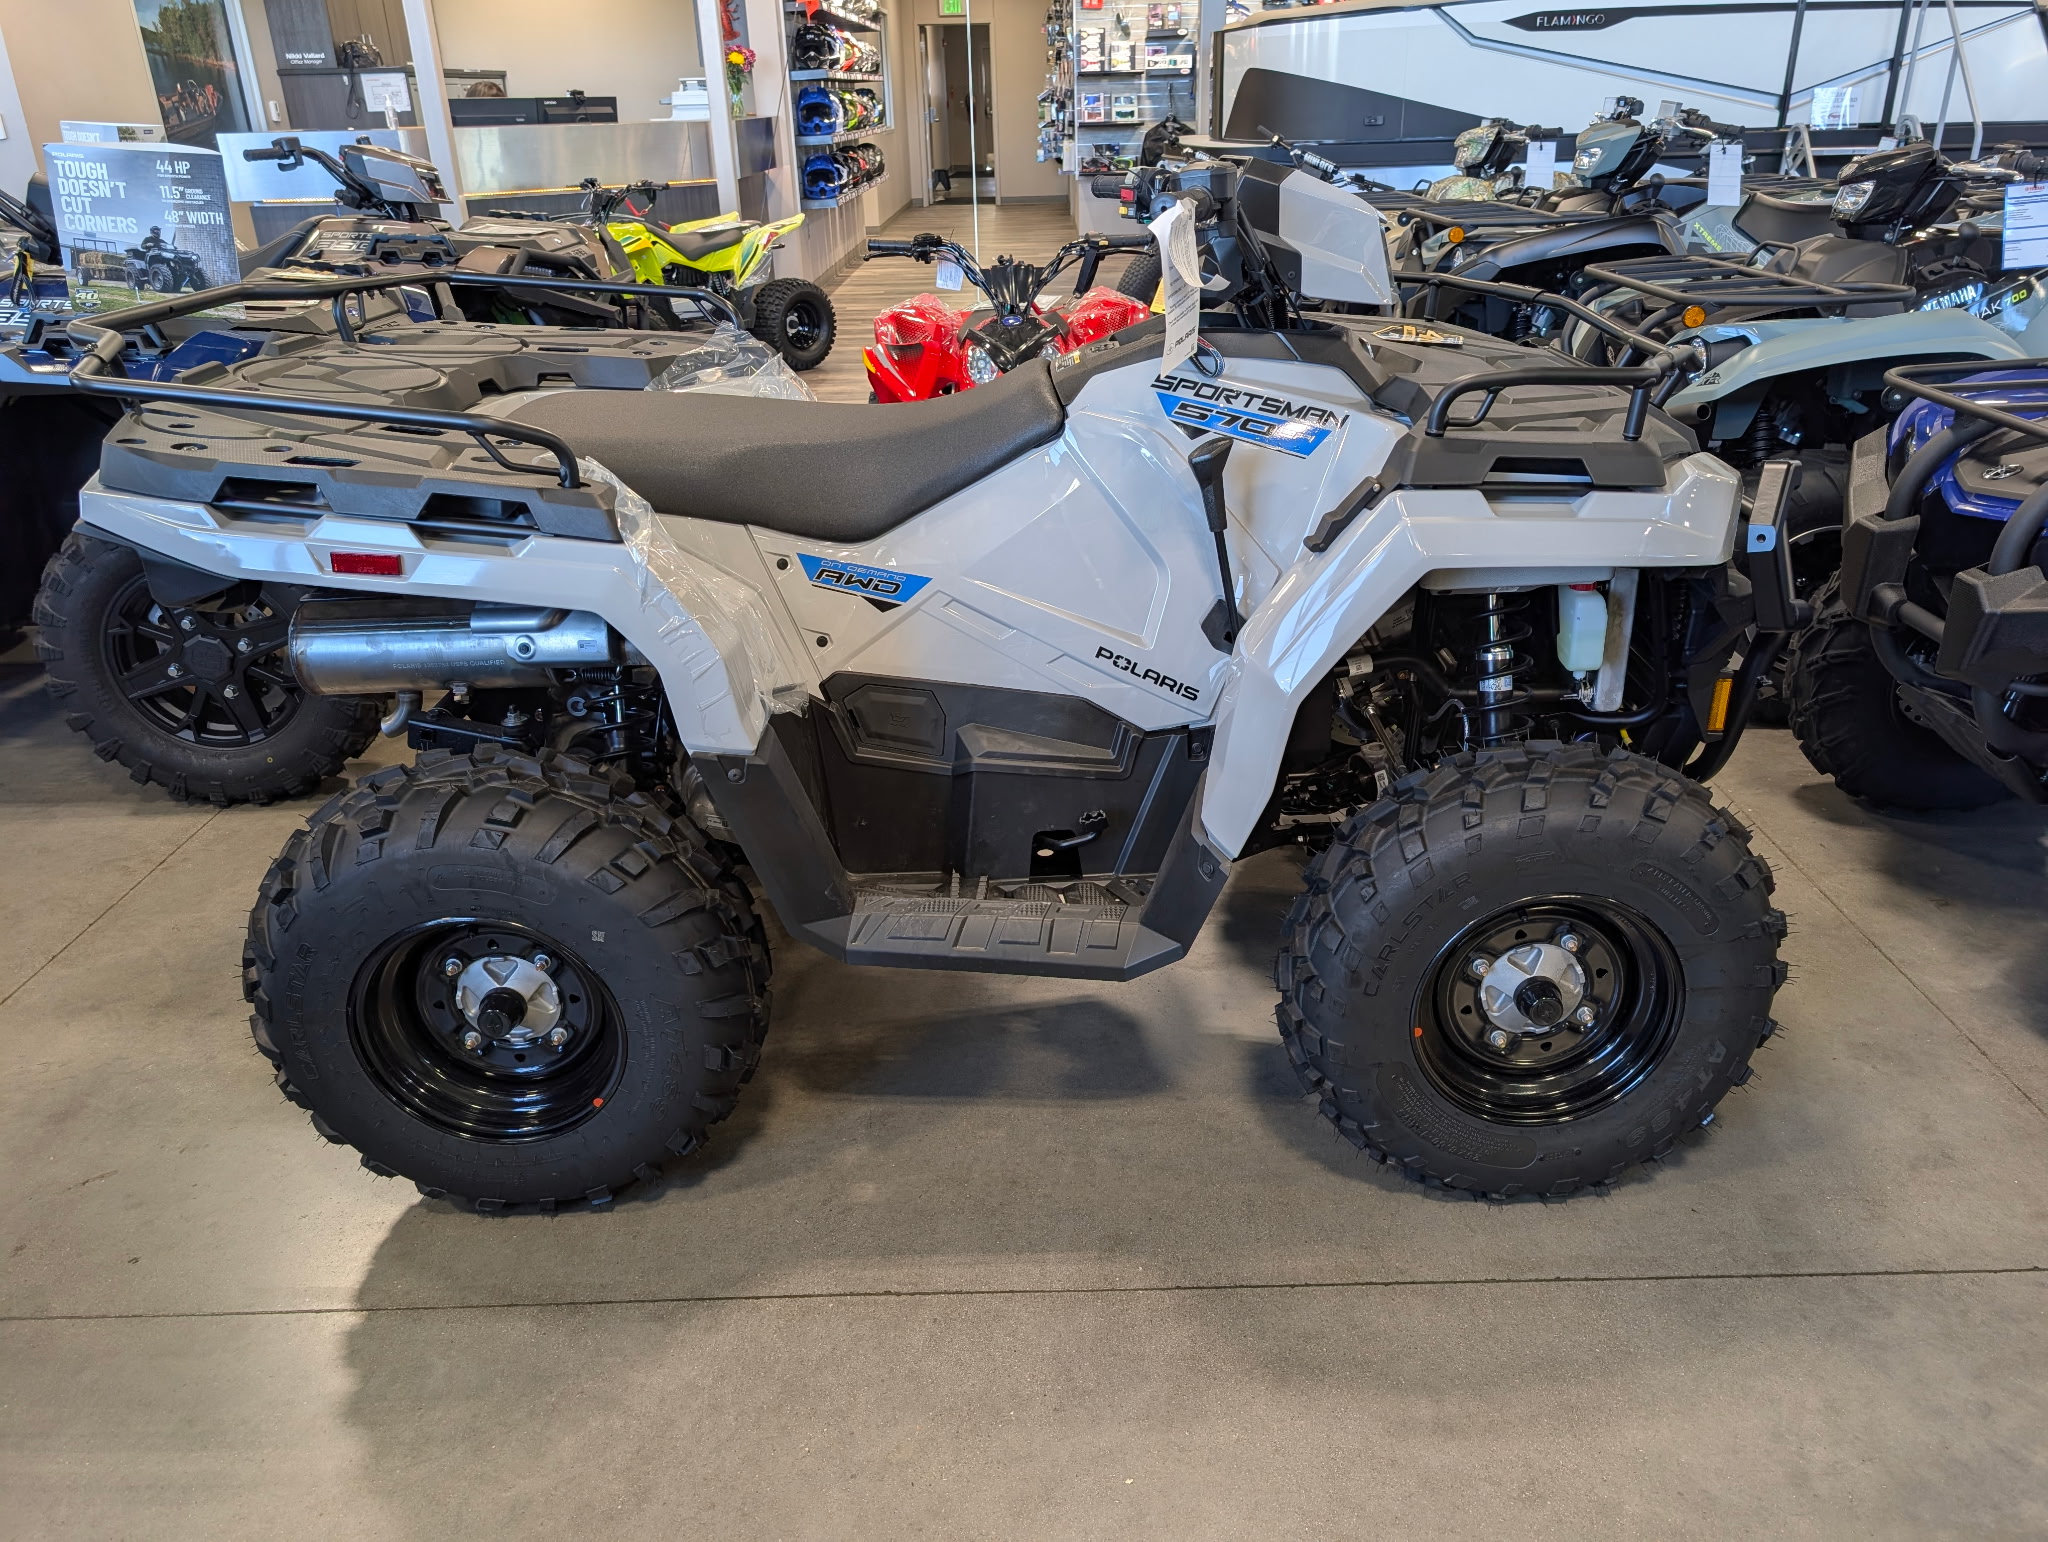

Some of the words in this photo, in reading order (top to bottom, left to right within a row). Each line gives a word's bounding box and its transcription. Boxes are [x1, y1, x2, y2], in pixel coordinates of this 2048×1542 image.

[1536, 14, 1605, 27] FLAMINGO
[54, 160, 108, 180] TOUGH
[156, 160, 173, 174] 44
[175, 162, 191, 174] HP
[58, 178, 126, 199] DOESN'T
[61, 196, 92, 214] CUT
[64, 214, 138, 234] CORNERS
[185, 211, 224, 225] WIDTH
[1693, 221, 1722, 252] XTREME
[1923, 285, 1976, 312] YAMAHA
[2004, 289, 2028, 306] 700
[1150, 373, 1350, 430] SPORTSMAN
[1173, 401, 1278, 437] 570
[820, 560, 841, 569] ON
[847, 565, 906, 581] DEMAND
[813, 568, 902, 595] AWD
[1095, 646, 1200, 701] POLARIS
[1362, 871, 1473, 998] CARLSTAR
